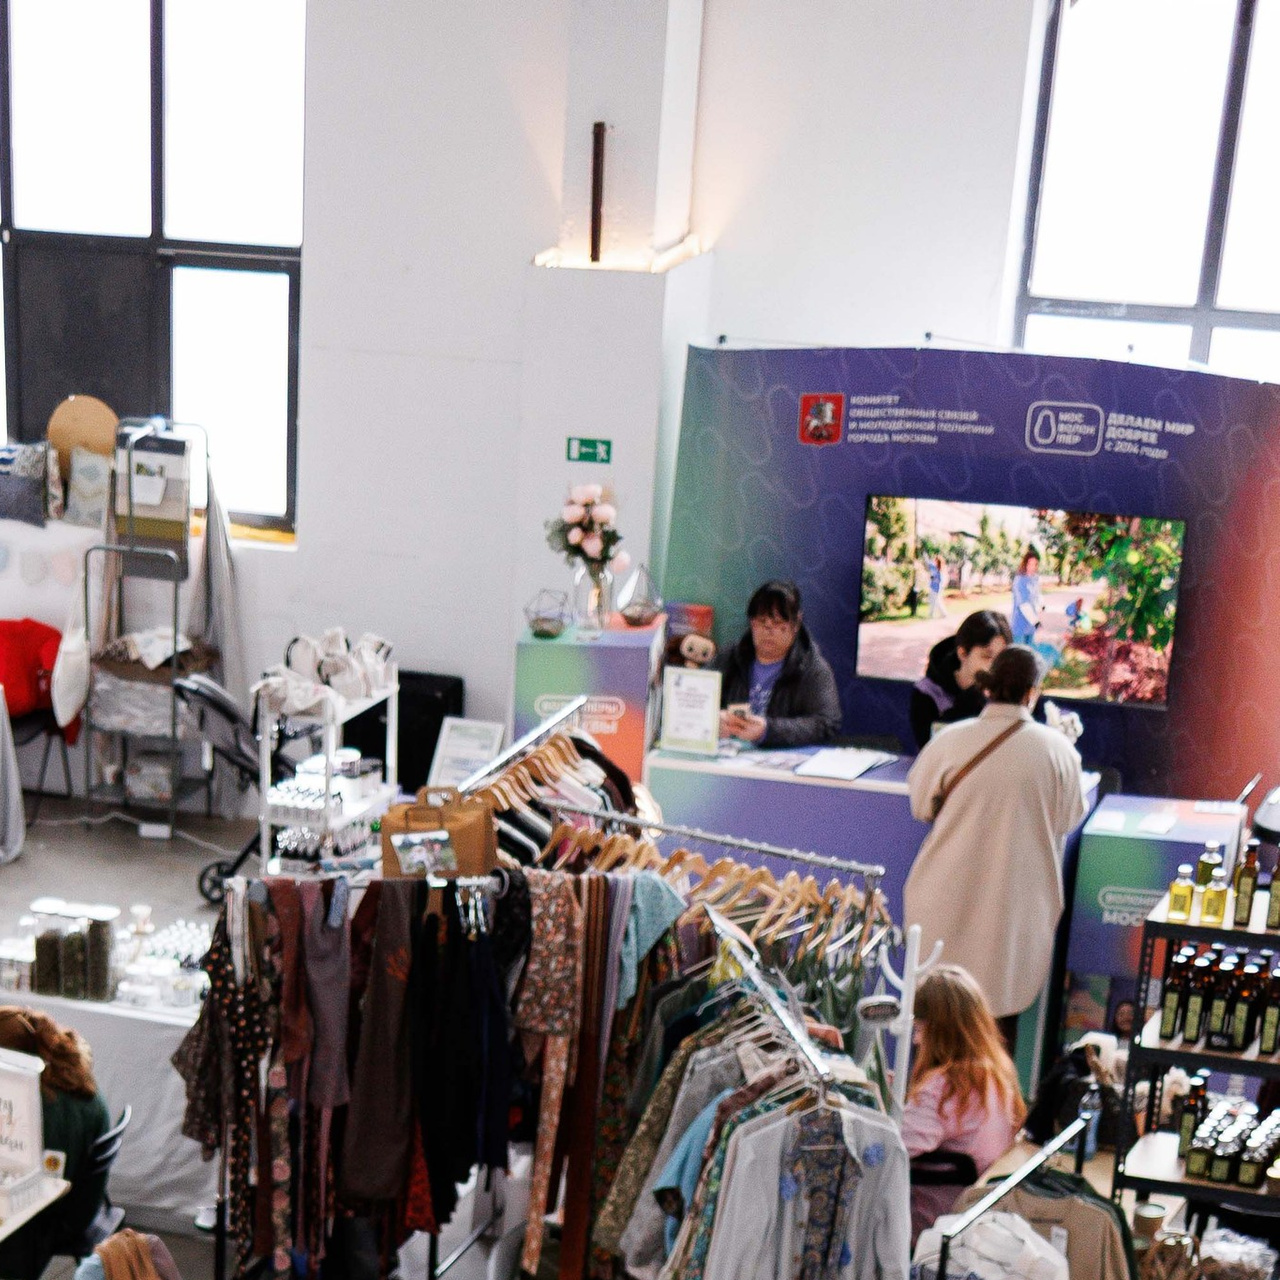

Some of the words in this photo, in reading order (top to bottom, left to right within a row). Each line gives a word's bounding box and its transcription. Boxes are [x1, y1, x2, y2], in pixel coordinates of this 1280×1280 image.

[1106, 412, 1163, 431] ДЕЛАЕМ
[1164, 421, 1195, 435] МИР
[1105, 426, 1158, 444] ДОБРЕЕ
[1102, 910, 1145, 927] МОС
